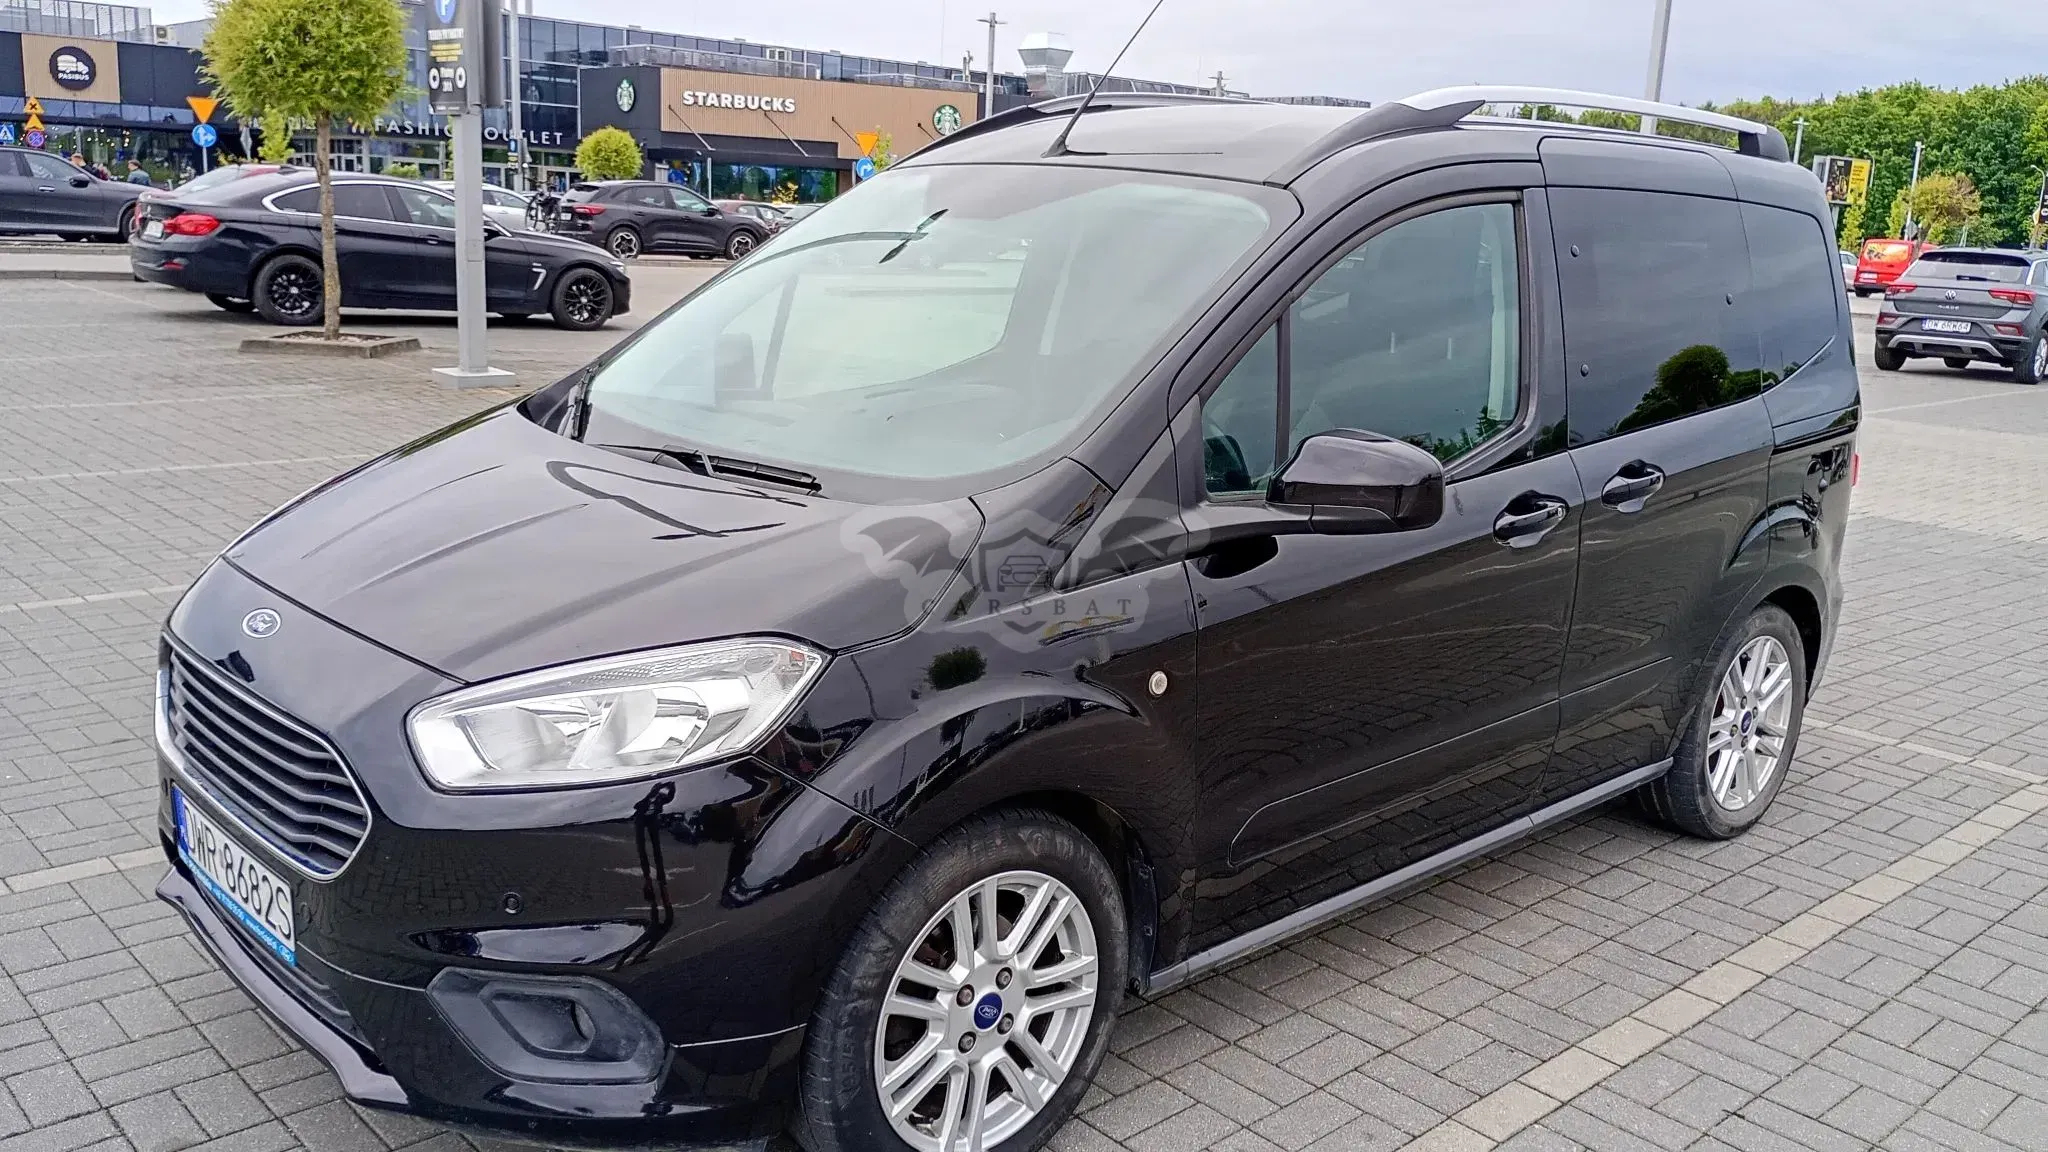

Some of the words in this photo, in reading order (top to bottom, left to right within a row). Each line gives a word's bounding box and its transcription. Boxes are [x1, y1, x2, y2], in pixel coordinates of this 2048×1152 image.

[58, 72, 90, 81] PASIBUS
[682, 90, 796, 113] STARBUCKS
[183, 802, 220, 881] DWR
[222, 842, 292, 941] 8682S
